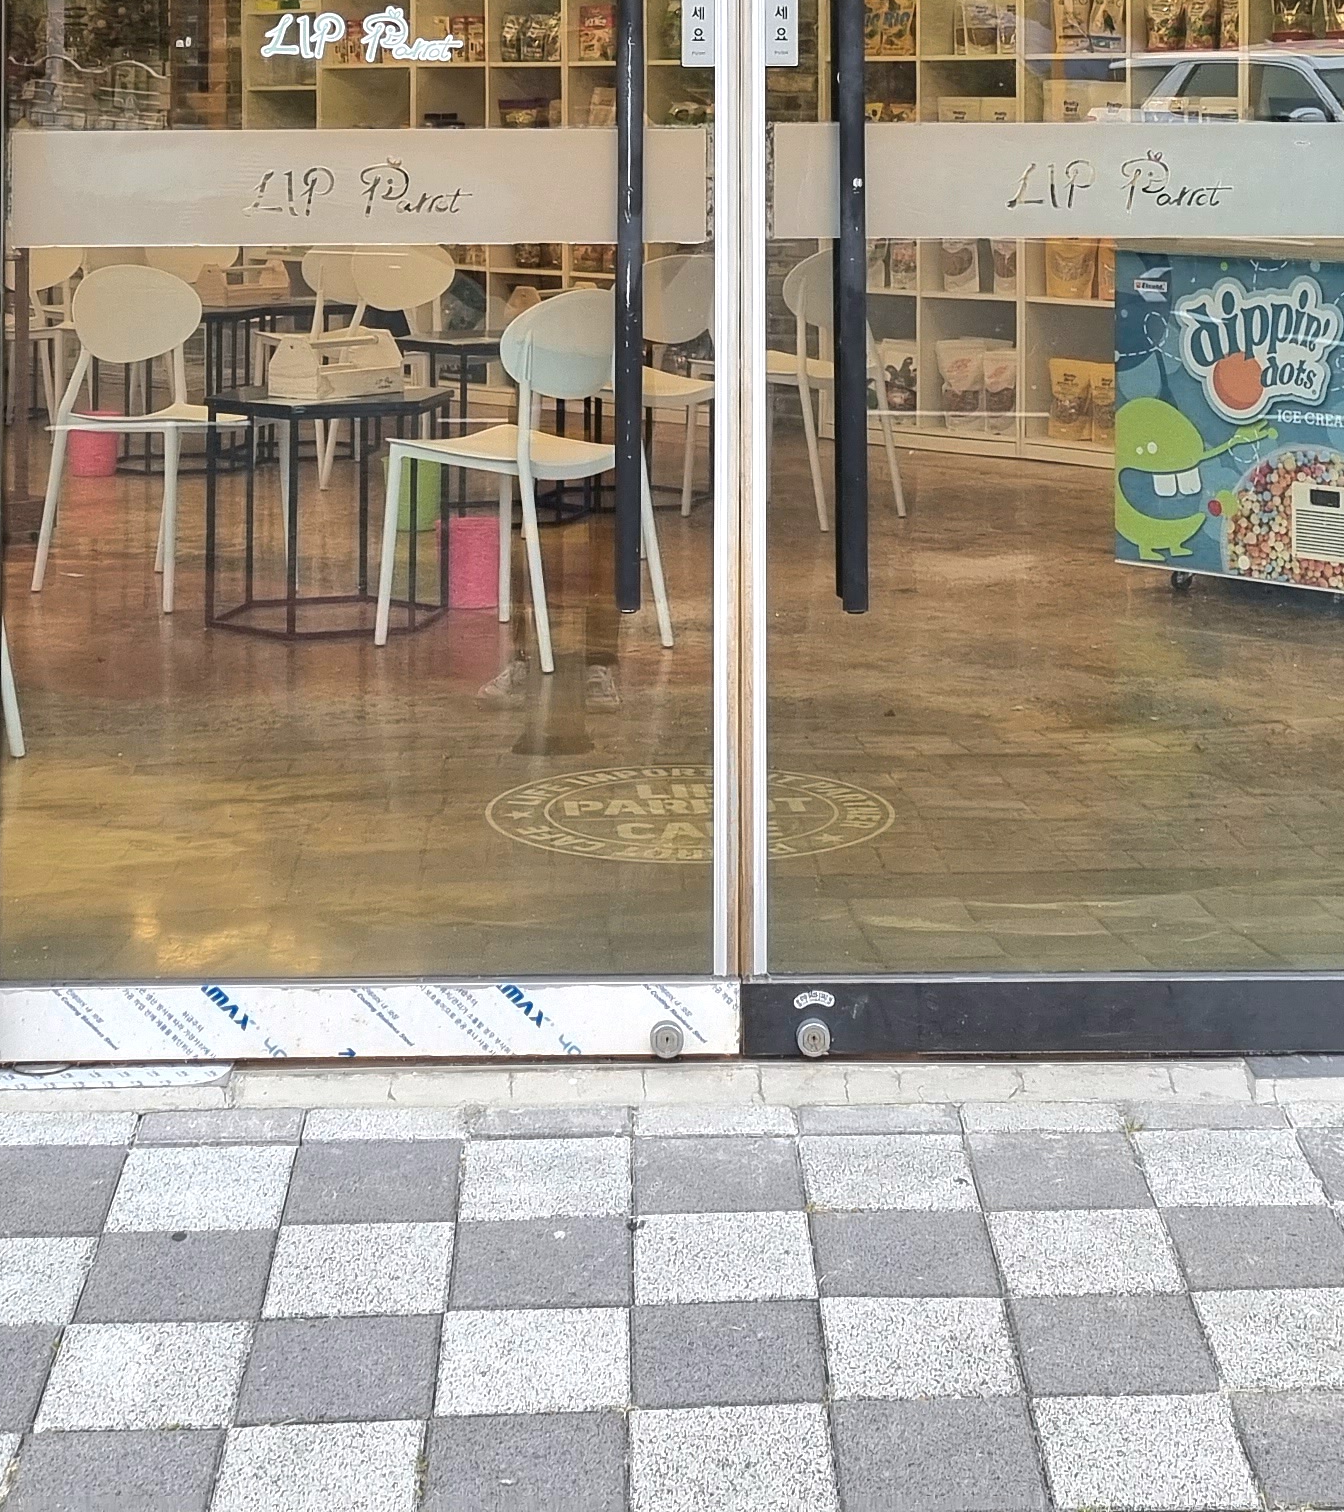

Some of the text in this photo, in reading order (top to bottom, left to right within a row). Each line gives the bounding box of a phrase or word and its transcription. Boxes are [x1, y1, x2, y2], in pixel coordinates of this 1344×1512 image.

[260, 13, 345, 60] LIP
[1260, 354, 1317, 390] dots
[1277, 410, 1303, 424] ICE
